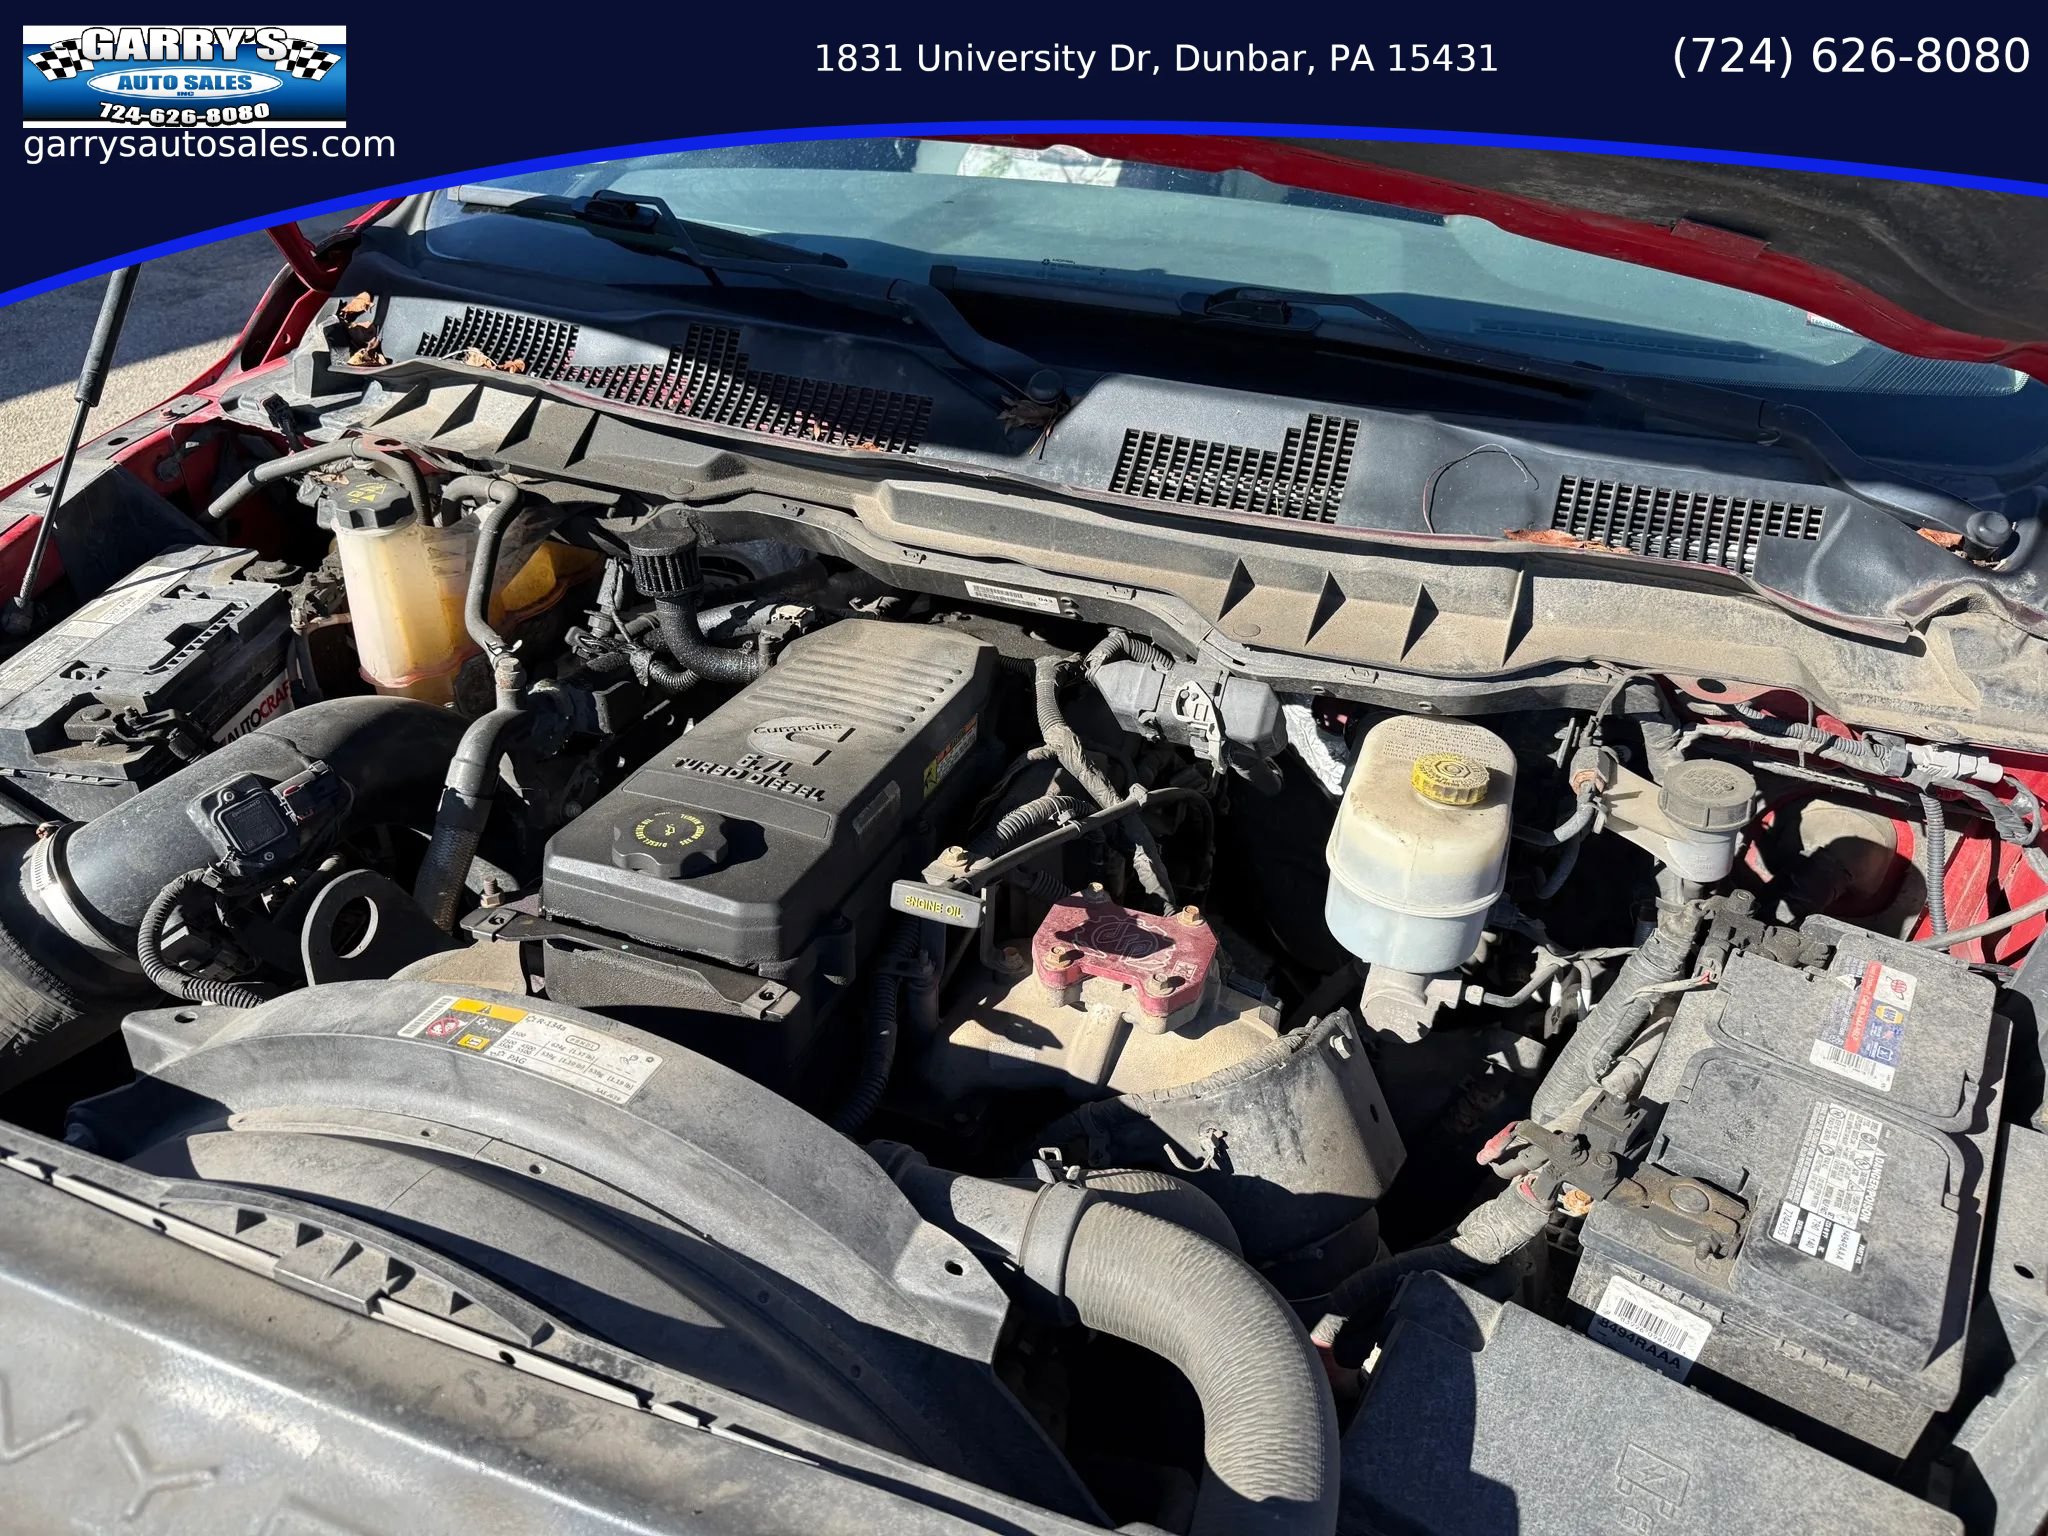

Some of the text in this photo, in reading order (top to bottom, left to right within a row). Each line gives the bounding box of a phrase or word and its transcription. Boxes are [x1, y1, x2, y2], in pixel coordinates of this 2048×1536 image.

[226, 680, 294, 742] AUTOCRAF
[753, 722, 843, 735] Cummins
[736, 753, 793, 777] 6.7L
[672, 756, 826, 801] TURBO DIESEL
[904, 896, 963, 917] ENGINE OIL
[536, 1018, 567, 1032] R-134a
[507, 1054, 527, 1064] PAG
[1599, 1317, 1680, 1369] 8494RAAA
